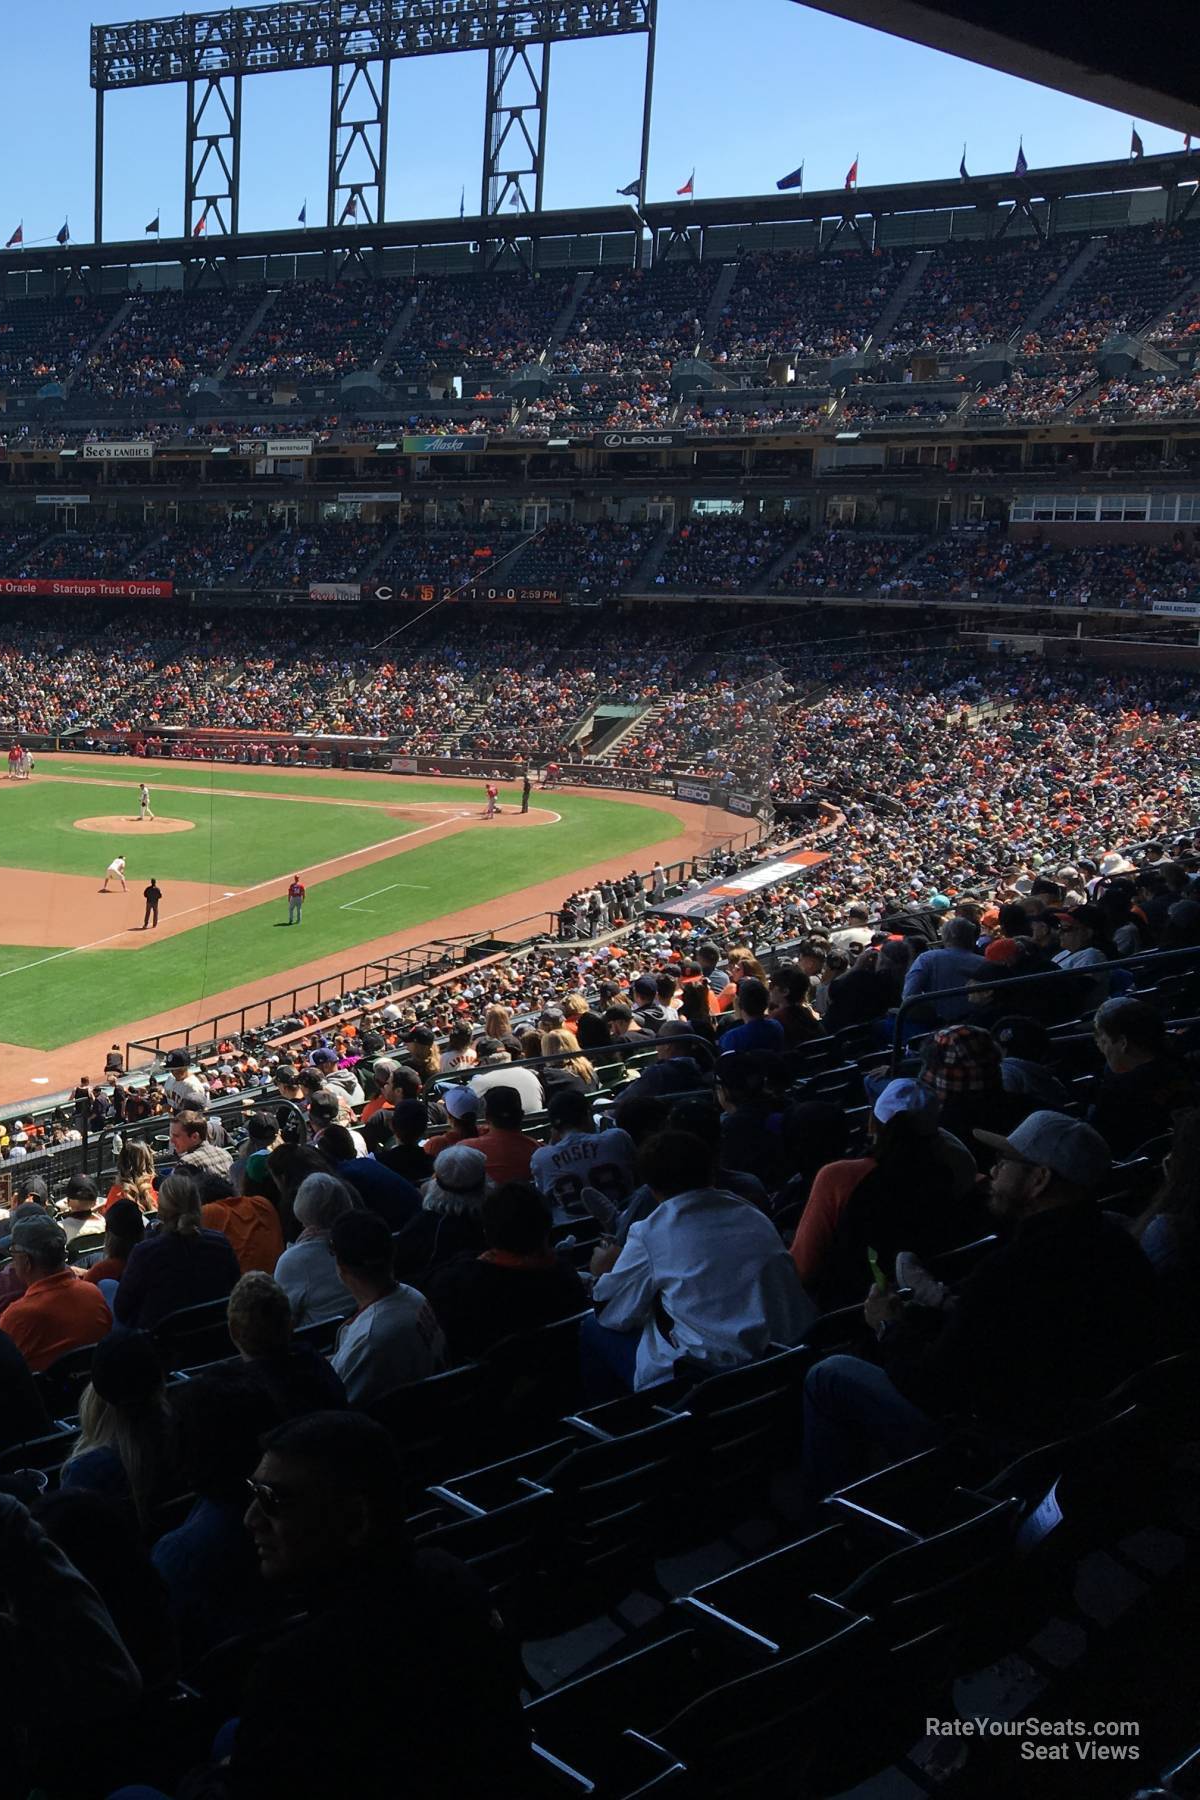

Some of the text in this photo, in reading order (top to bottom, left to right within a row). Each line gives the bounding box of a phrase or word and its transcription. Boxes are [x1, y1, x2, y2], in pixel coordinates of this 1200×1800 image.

[424, 438, 464, 451] Alaska
[622, 435, 673, 445] LEXUS
[85, 447, 111, 457] See's
[5, 582, 36, 593] Oracle
[53, 583, 161, 595] Startups Trust Oracle
[543, 590, 557, 599] PM
[677, 786, 710, 801] GEICO
[729, 797, 752, 813] GEICO
[551, 1142, 600, 1169] POSEY
